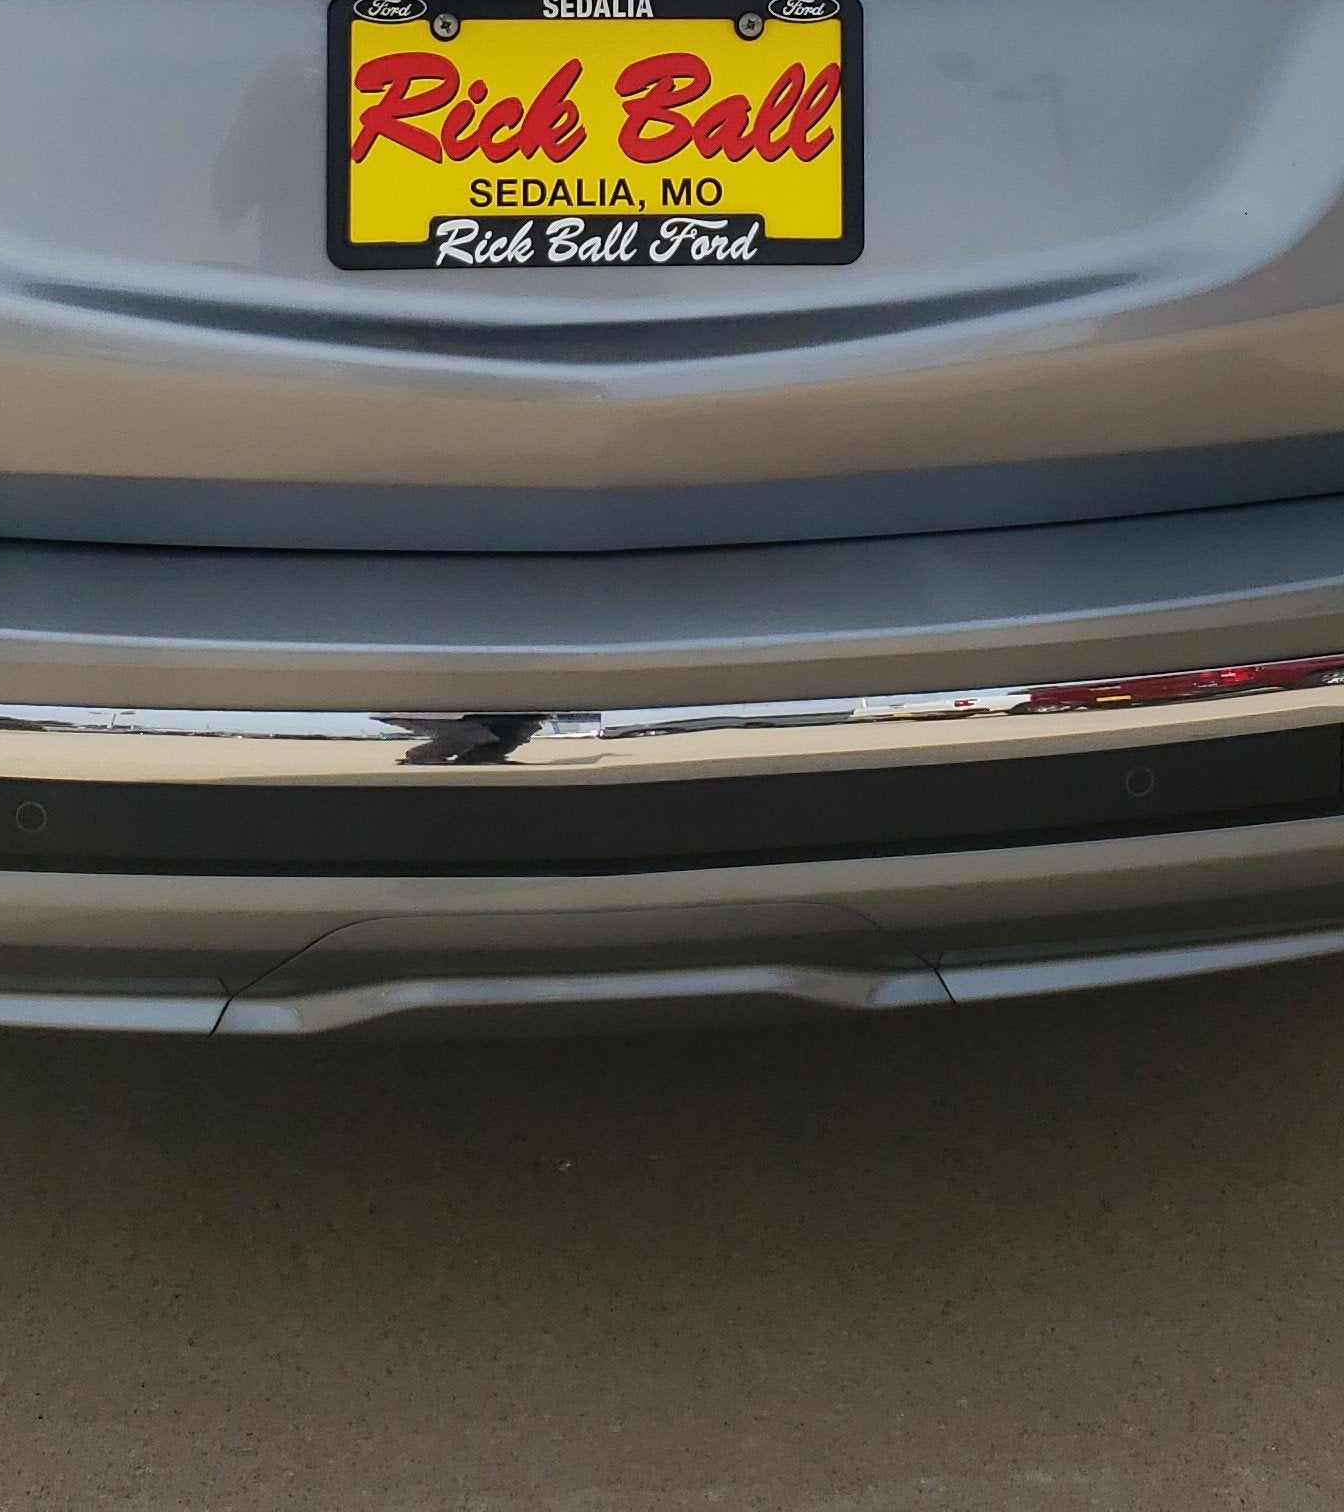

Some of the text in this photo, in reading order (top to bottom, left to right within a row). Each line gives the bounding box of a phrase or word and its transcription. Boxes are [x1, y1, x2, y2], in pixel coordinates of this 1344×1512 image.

[350, 51, 841, 164] Rick Ball
[469, 176, 723, 213] SEDALIA, MO
[436, 216, 758, 265] Rick Ball Ford
